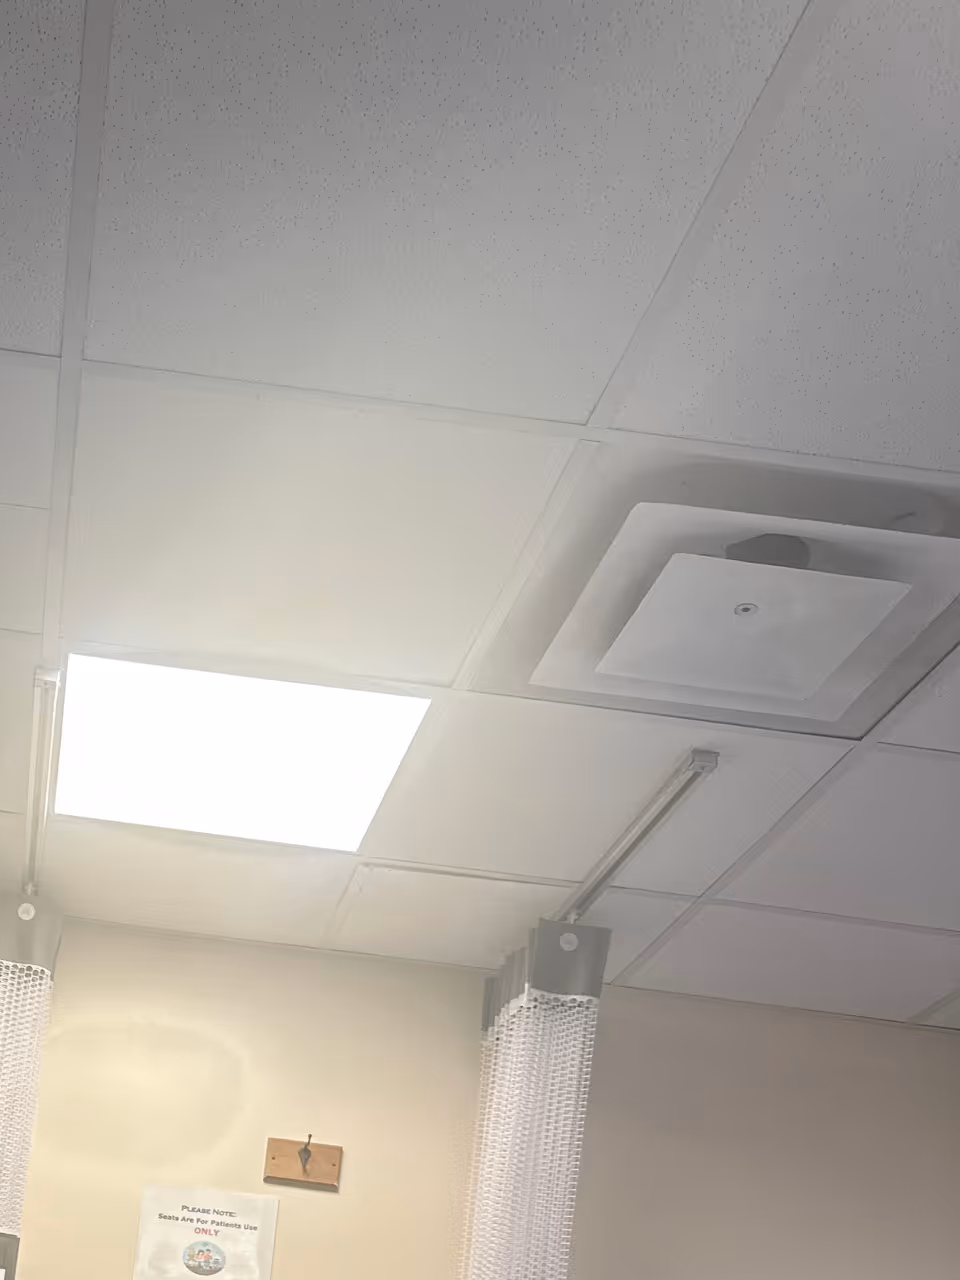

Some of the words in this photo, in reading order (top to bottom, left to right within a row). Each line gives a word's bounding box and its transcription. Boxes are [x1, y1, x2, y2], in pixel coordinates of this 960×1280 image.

[181, 1204, 211, 1214] PLEASE
[158, 1213, 179, 1222] Seats
[181, 1216, 194, 1224] Are
[210, 1220, 241, 1229] Patients
[194, 1227, 220, 1236] ONLY
